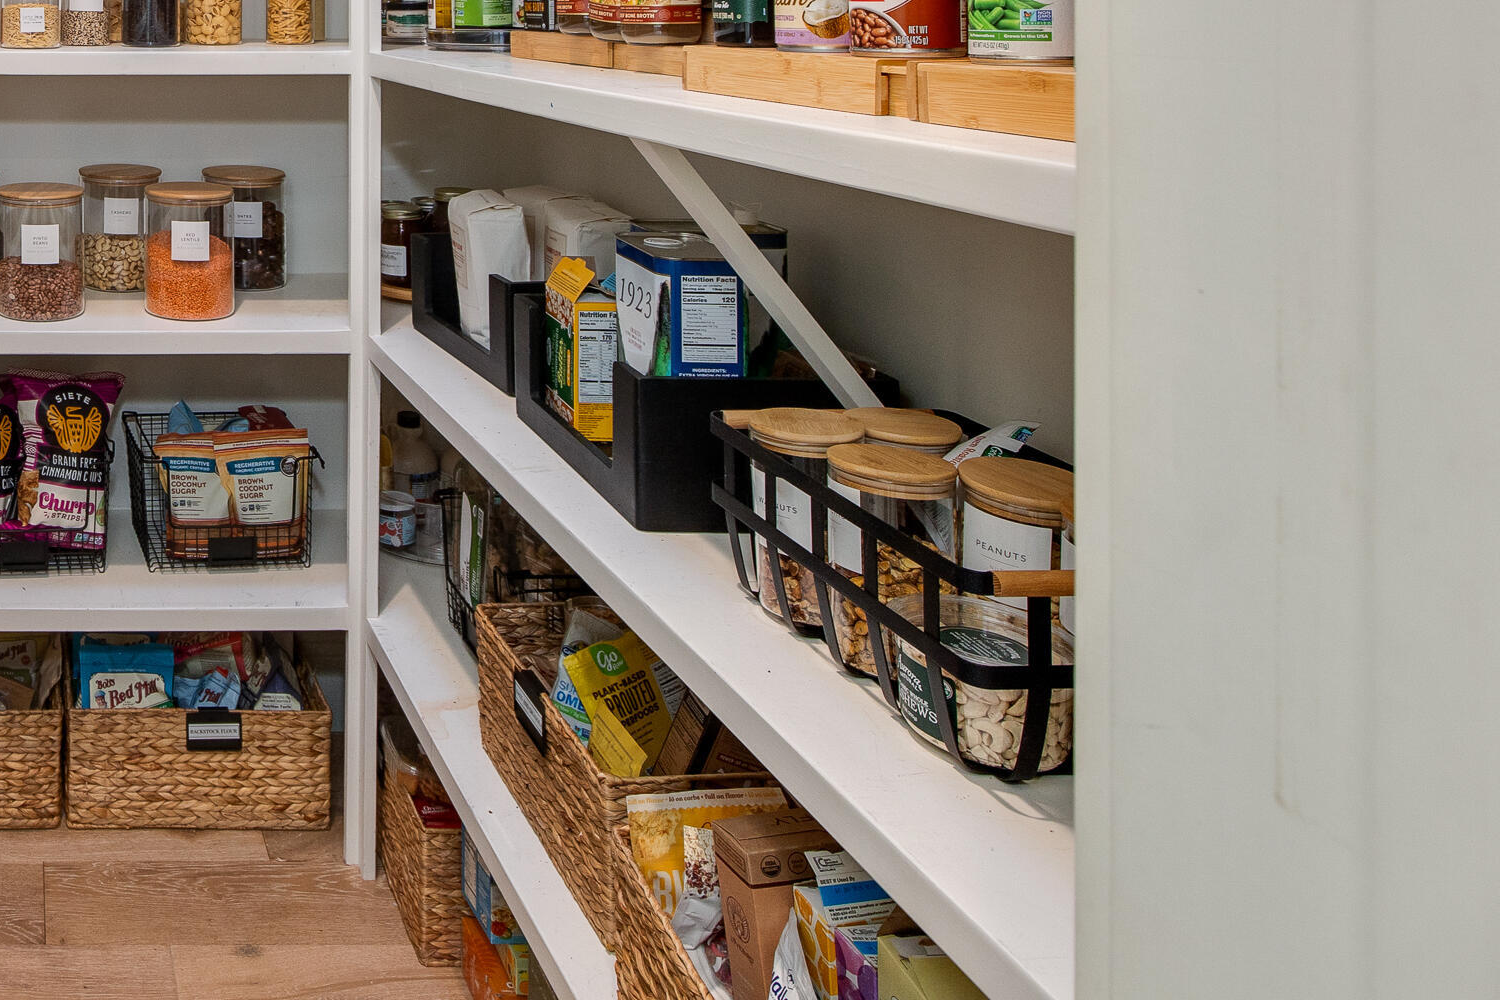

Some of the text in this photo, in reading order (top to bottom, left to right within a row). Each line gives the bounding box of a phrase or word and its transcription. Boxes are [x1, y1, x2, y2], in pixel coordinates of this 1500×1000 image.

[908, 25, 929, 34] NET WT
[682, 276, 736, 284] Nutrition Facts
[619, 278, 652, 319] 1923
[579, 311, 608, 319] Nutrition
[54, 391, 92, 405] SIETE
[52, 454, 77, 466] GRAIN
[169, 459, 210, 467] REGENERATIVE
[234, 460, 276, 468] REGENERATIVE
[41, 465, 84, 482] CINNAMON
[238, 484, 274, 492] COCONUT
[39, 491, 96, 515] Churro
[51, 512, 81, 522] STRIPS
[975, 538, 1028, 563] PEANUTS
[95, 678, 116, 690] Bob's
[592, 669, 647, 700] PLANT-BASED
[108, 678, 159, 709] Red Mill
